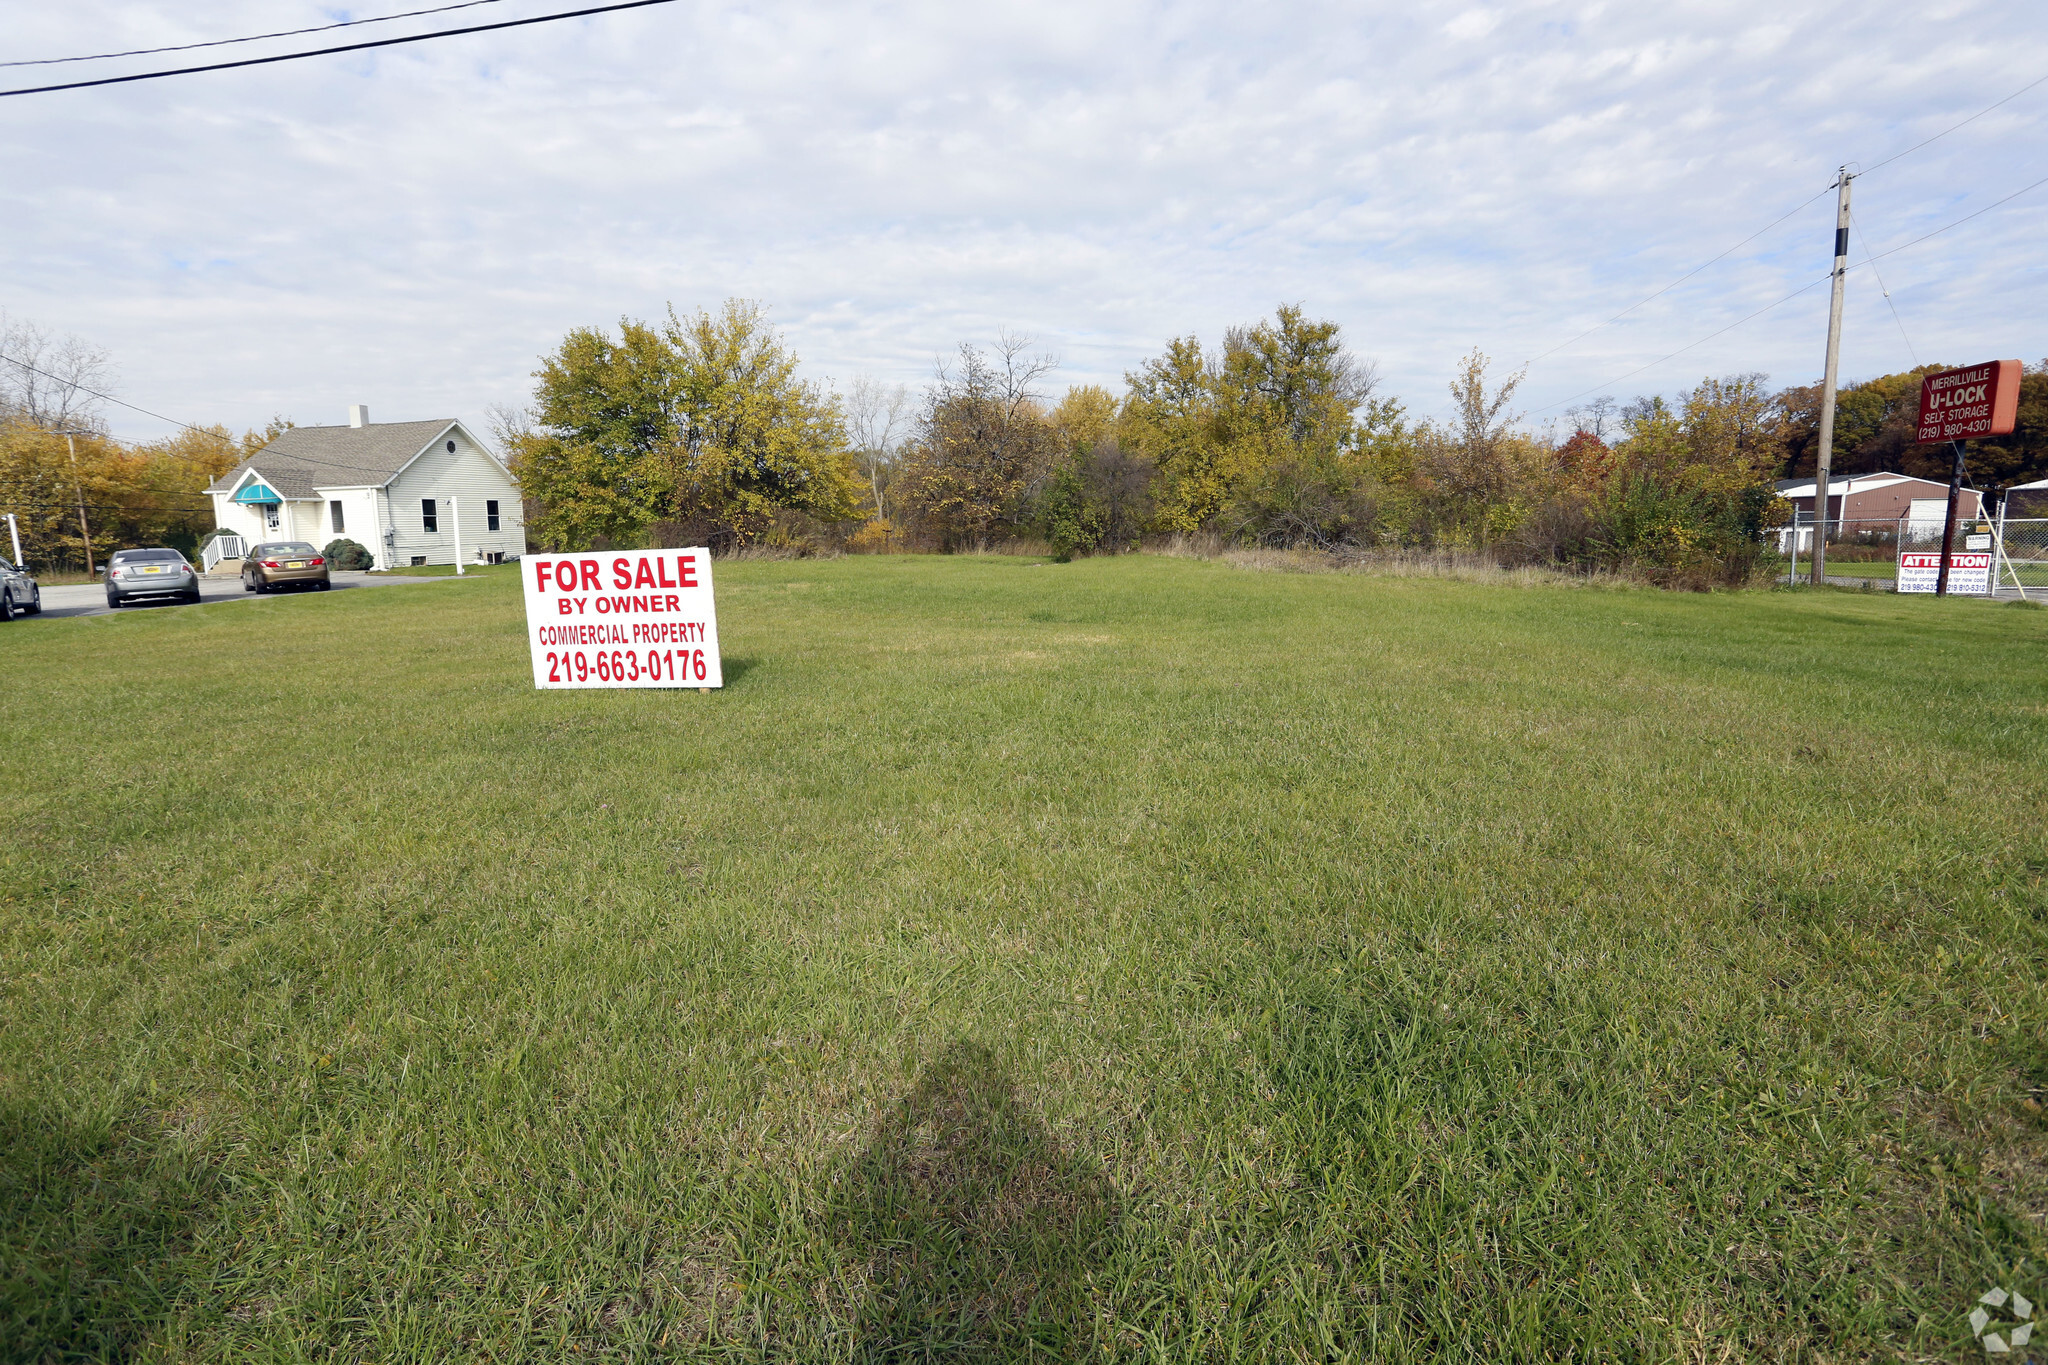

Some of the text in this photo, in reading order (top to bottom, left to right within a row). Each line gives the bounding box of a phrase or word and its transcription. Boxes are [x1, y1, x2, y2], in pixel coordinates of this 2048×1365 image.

[1932, 368, 1990, 390] MERRILLVILLE
[1930, 384, 1988, 409] U-LOCK
[1924, 404, 1989, 424] SELF STORAGE
[1918, 419, 1991, 440] (219) 980-4301
[1903, 556, 1988, 567] ATTETION
[536, 556, 698, 592] FOR SALE
[558, 595, 681, 615] BY OWNER
[539, 622, 705, 645] COMMERCIAL PROPERTY
[546, 649, 706, 682] 219-663-0176
